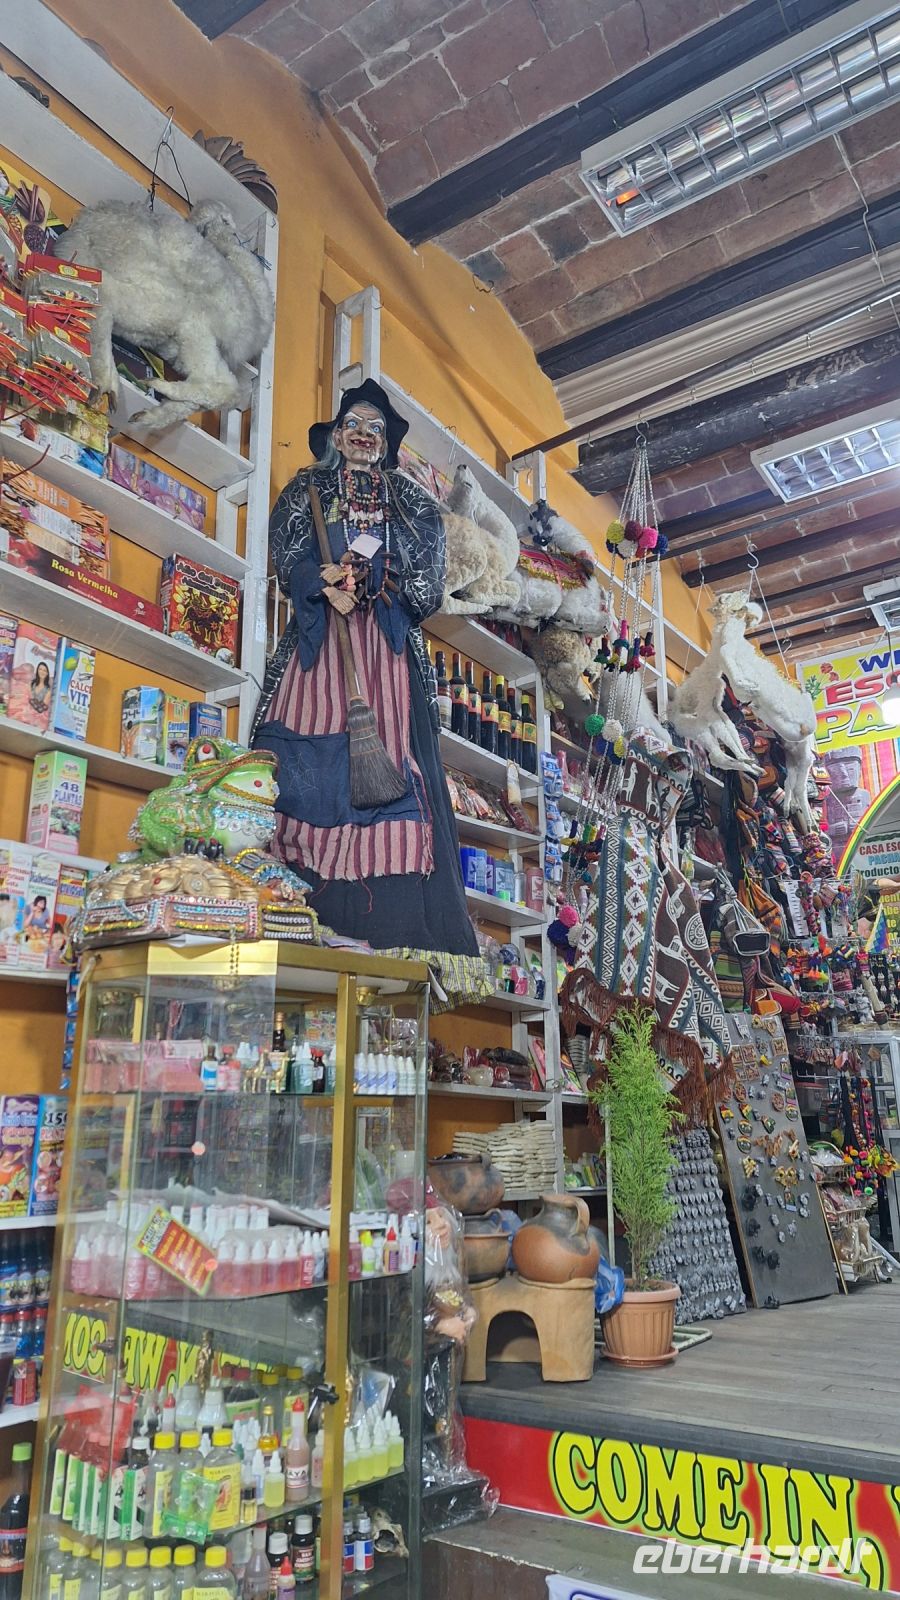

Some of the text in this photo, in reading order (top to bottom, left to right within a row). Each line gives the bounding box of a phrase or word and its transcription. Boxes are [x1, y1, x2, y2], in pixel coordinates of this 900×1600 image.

[51, 558, 75, 577] Rosa
[77, 571, 119, 599] Vermelha
[60, 781, 79, 793] 48
[859, 843, 885, 856] CASA
[551, 1430, 751, 1550] COME
